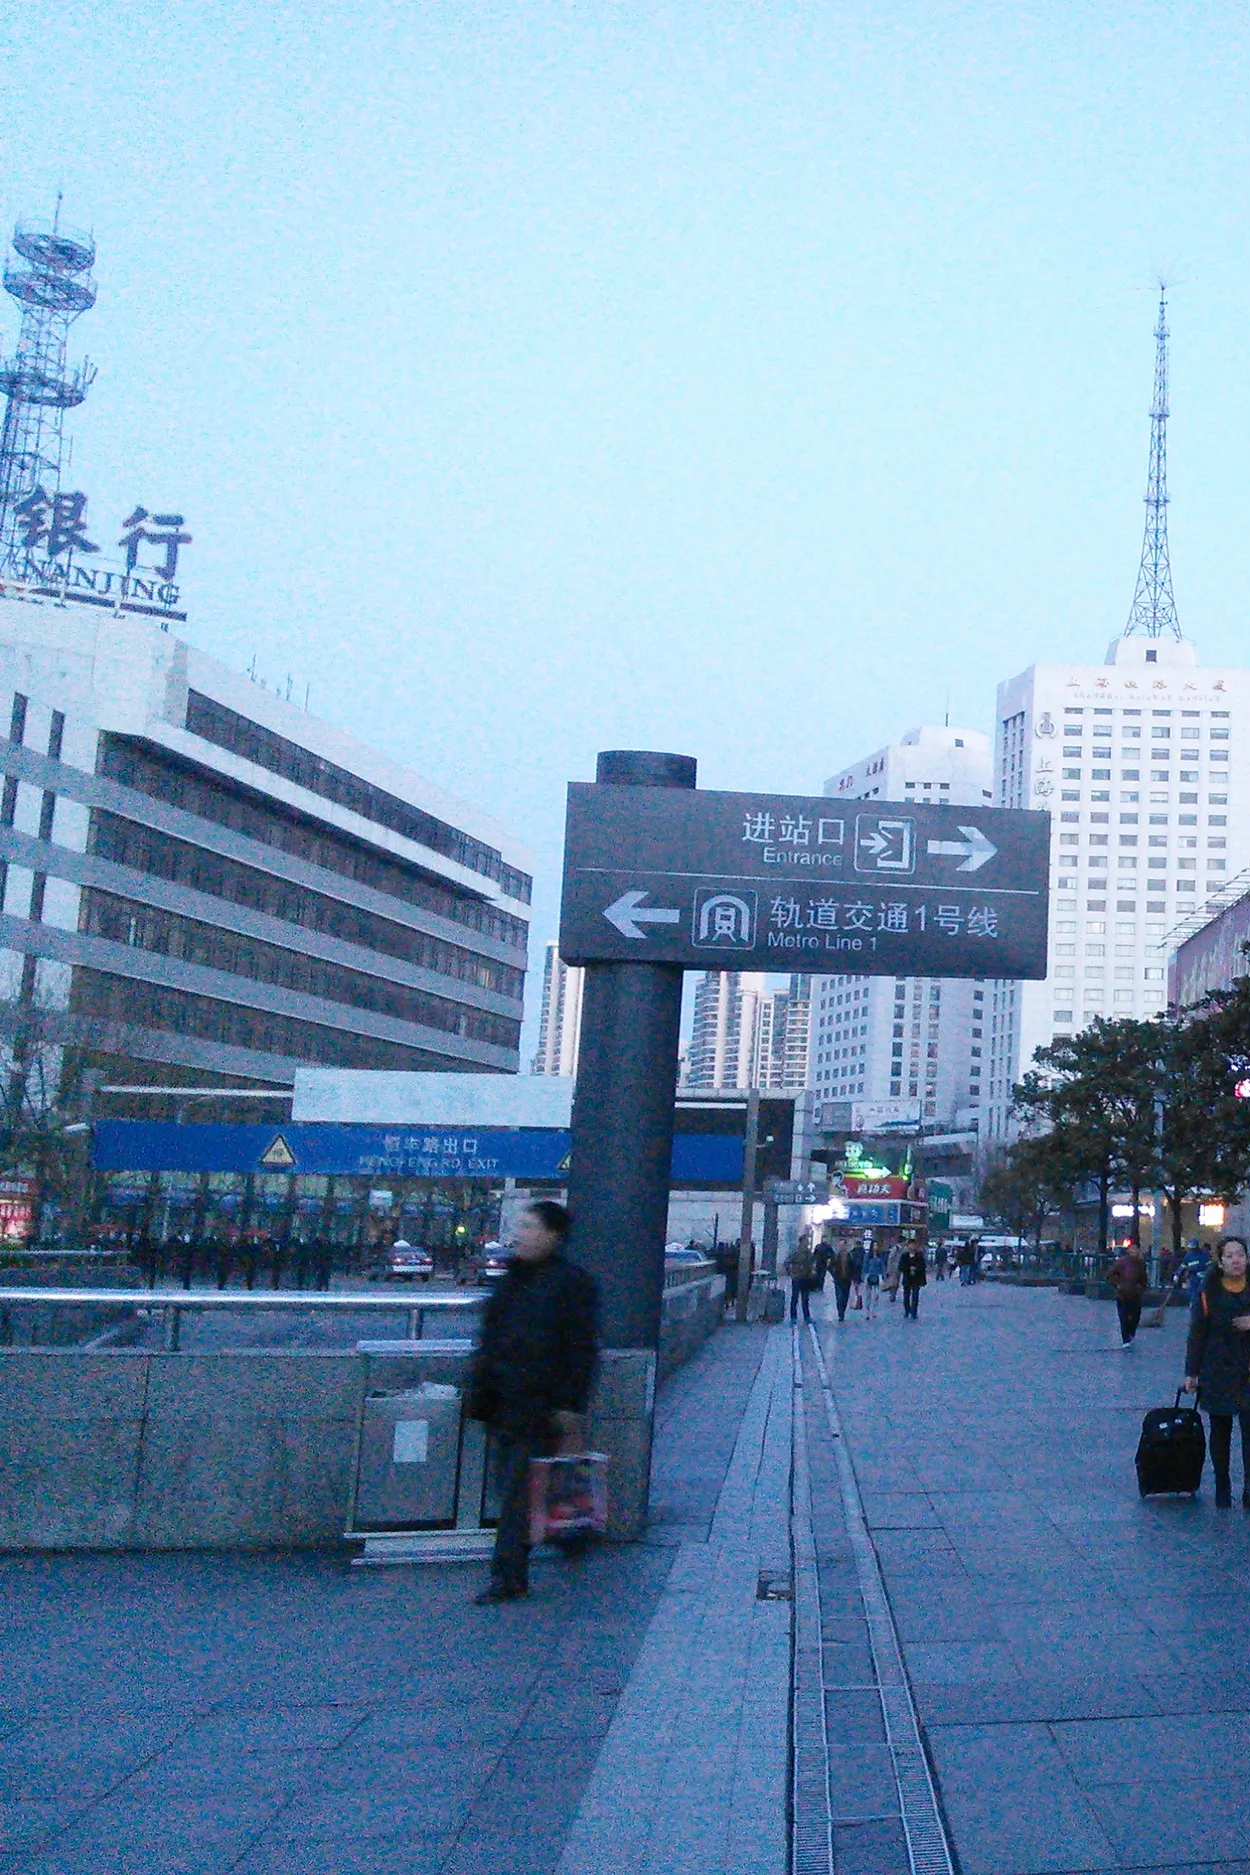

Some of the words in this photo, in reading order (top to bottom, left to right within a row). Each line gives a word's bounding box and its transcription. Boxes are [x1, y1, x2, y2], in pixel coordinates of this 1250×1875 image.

[741, 811, 845, 846] 进站口
[763, 846, 844, 867] Entrance
[769, 895, 1000, 939] 轨道交通1号线
[767, 931, 819, 950] Metro
[825, 933, 863, 951] Line
[870, 936, 877, 951] 1
